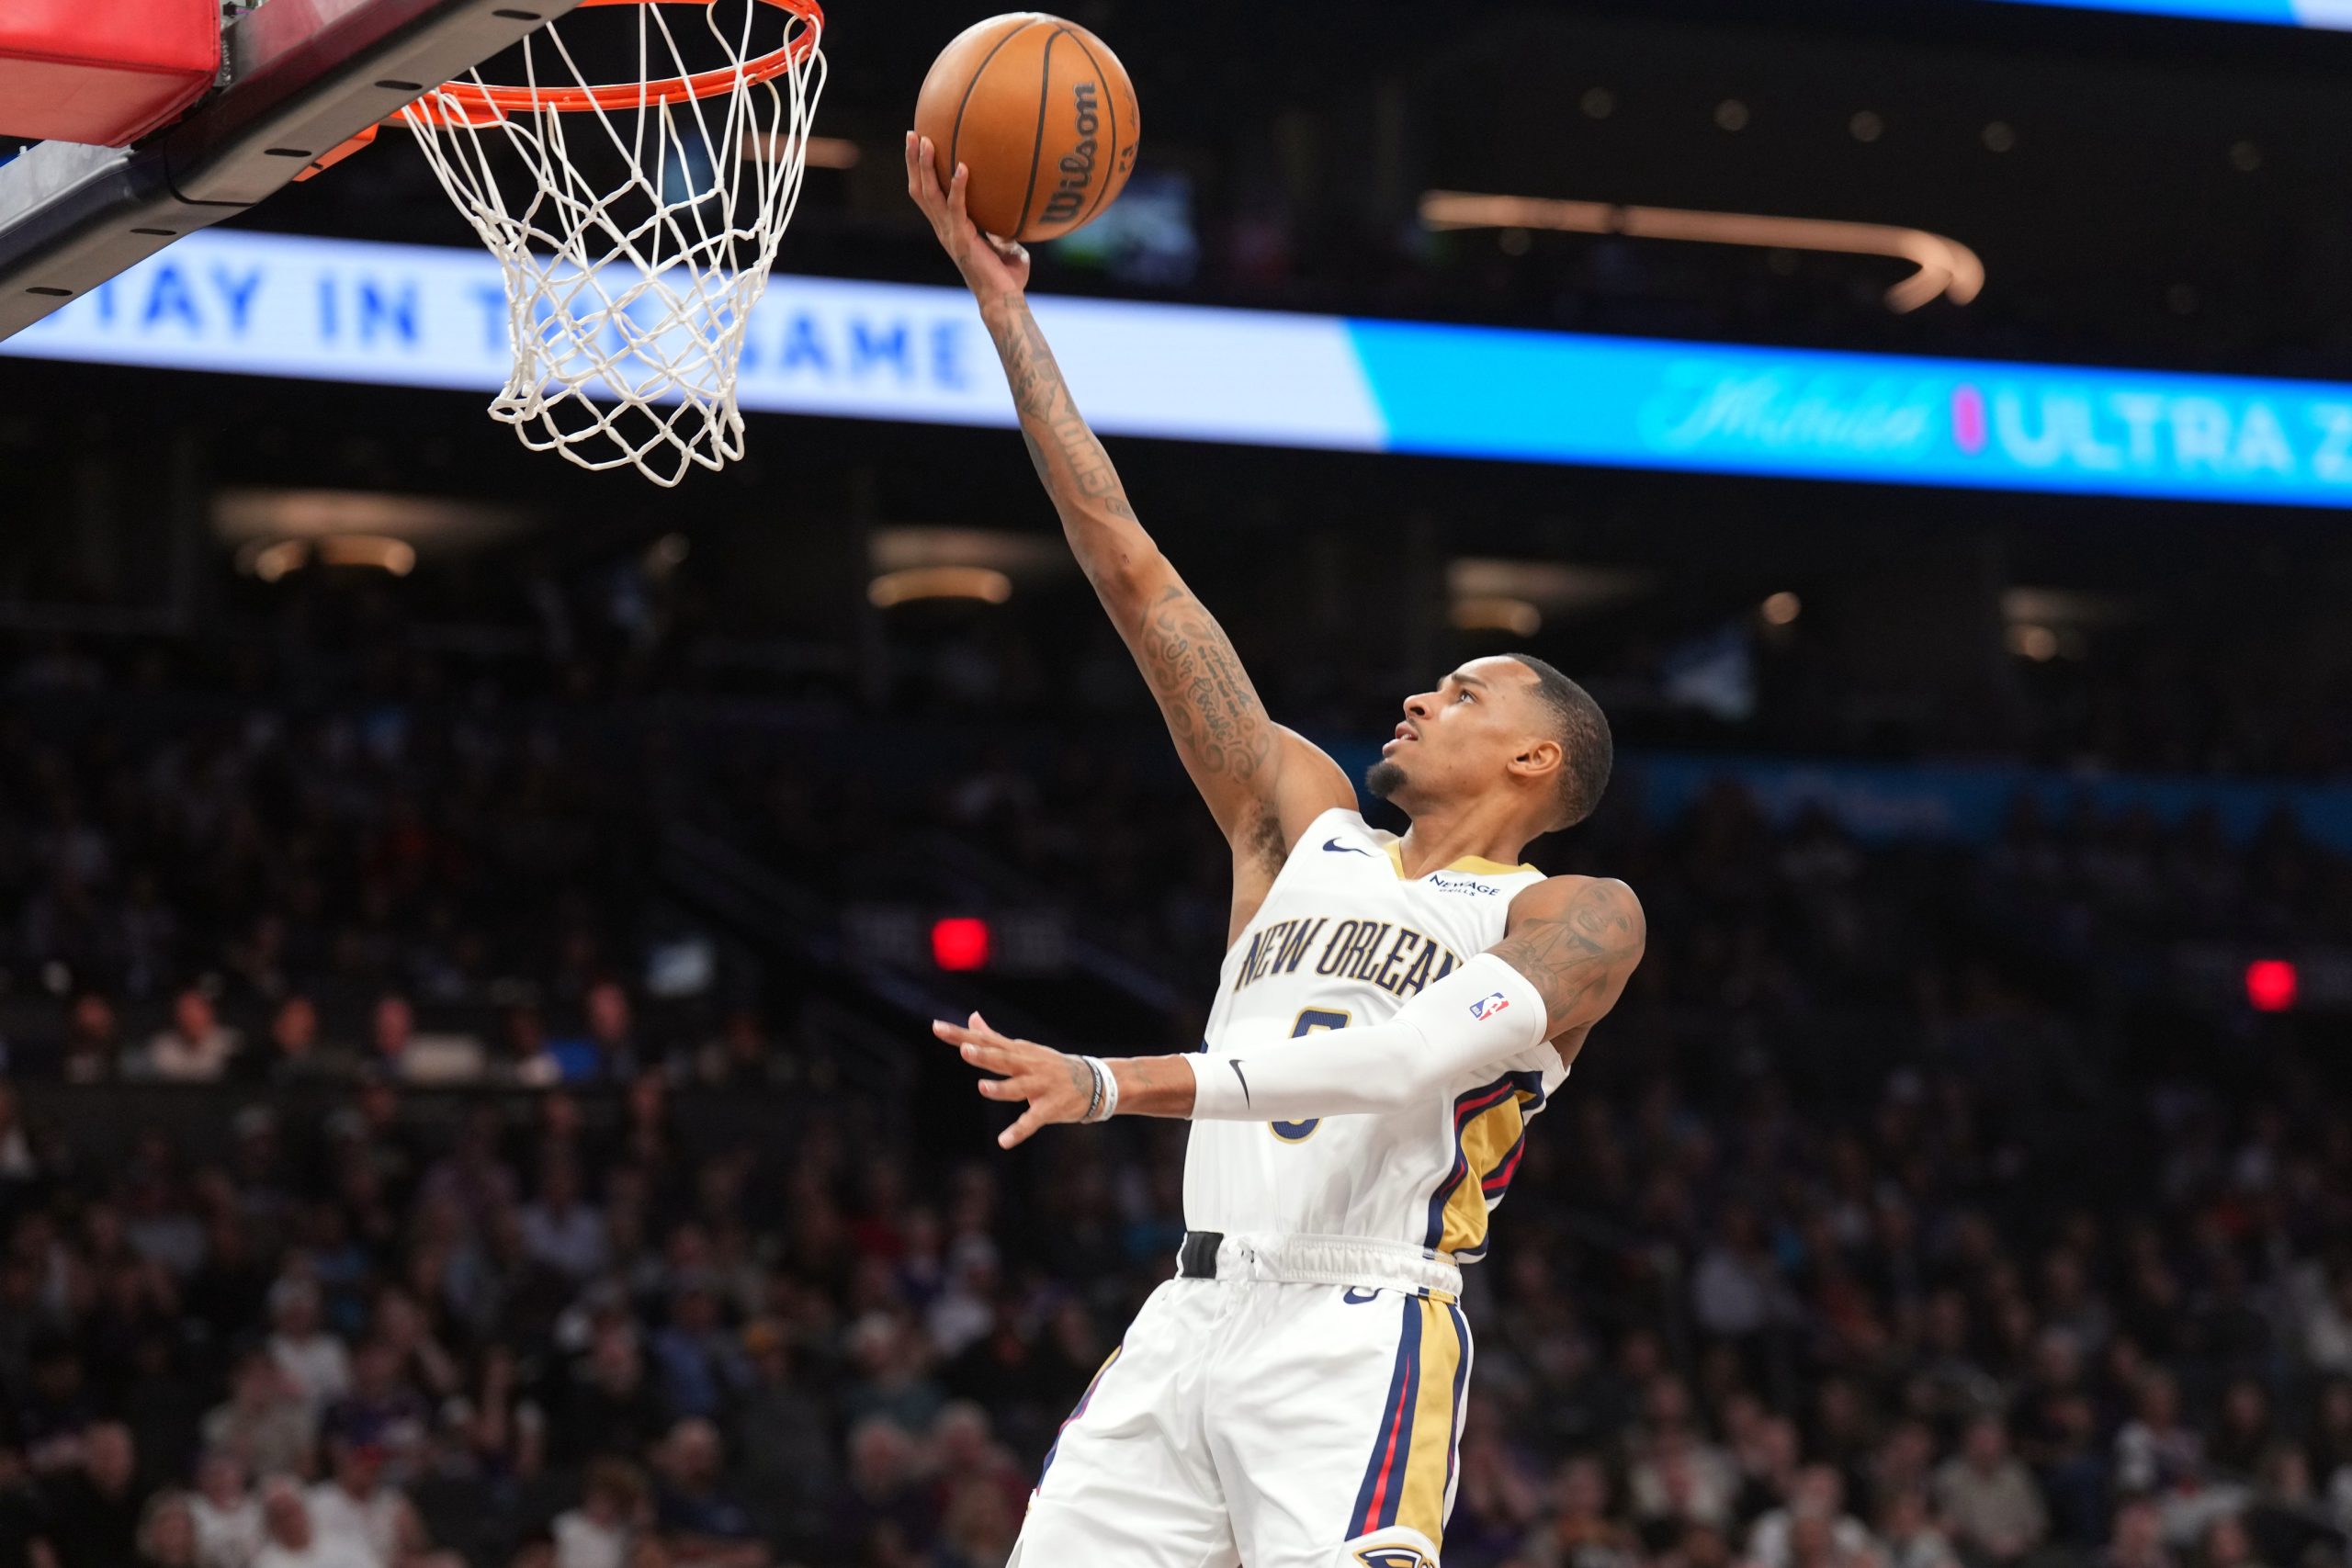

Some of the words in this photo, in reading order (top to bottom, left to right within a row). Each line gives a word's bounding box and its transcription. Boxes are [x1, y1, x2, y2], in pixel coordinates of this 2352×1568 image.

[1040, 81, 1098, 223] Wilson
[316, 268, 421, 347] IN
[1992, 384, 2297, 478] ULTRA
[1232, 917, 1329, 994] NEW
[1316, 919, 1465, 999] ORLEAN
